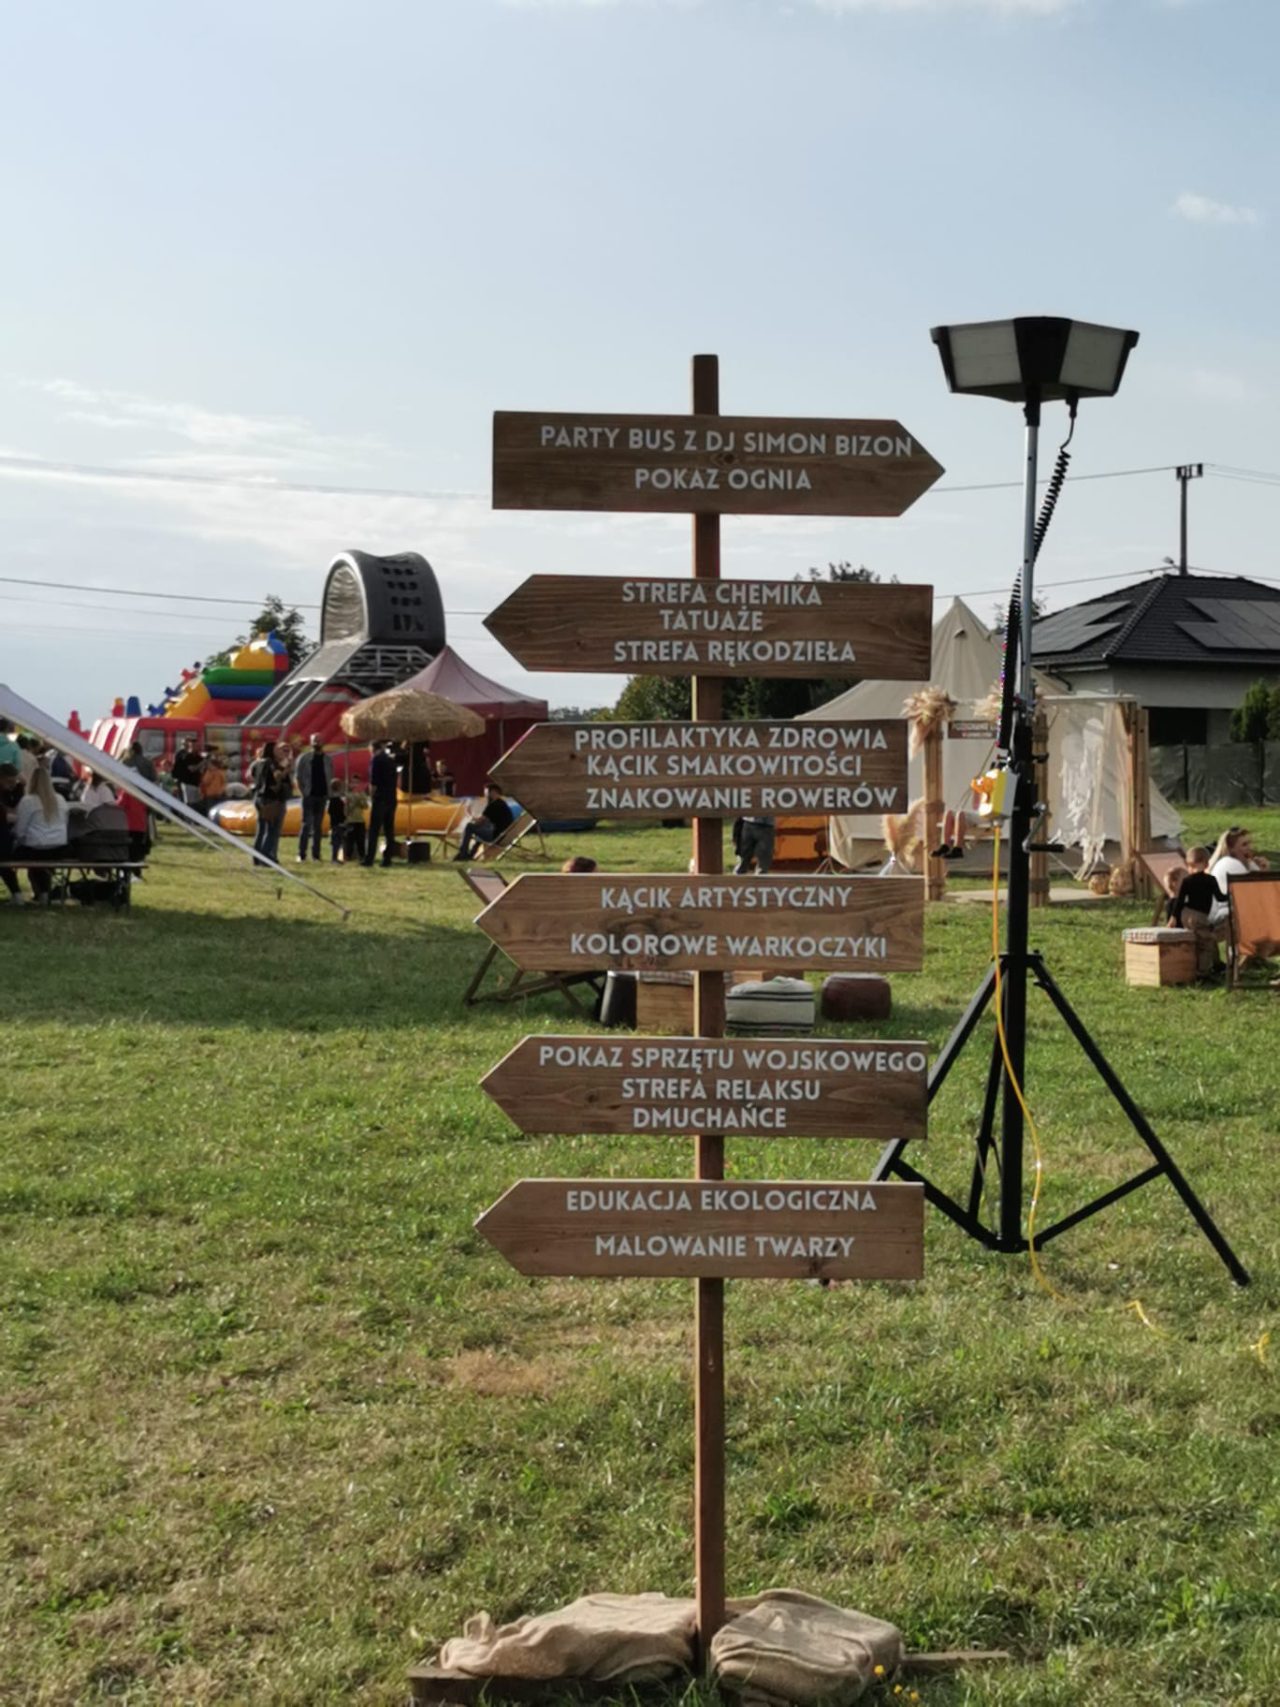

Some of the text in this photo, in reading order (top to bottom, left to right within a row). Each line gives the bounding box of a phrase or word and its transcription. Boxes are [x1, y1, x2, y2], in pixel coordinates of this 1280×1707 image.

[541, 426, 912, 456] PARTY BUS Z DJ SIMON BIZON
[635, 469, 811, 490] POKAZ OGNIA
[622, 582, 821, 606] STREFA CHEMIKA
[660, 604, 763, 631] TATUAŻE
[614, 641, 855, 668] STREFA RĘKODZIEŁA
[575, 727, 887, 750] PROFILAKTYKA ZDROWIA
[587, 751, 862, 782] KĄCIK SMAKOWITOŚCI
[587, 783, 897, 809] ZNAKOWANIE ROWERÓW
[601, 886, 852, 913] KĄCIK ARTYSTYCZNY
[571, 933, 886, 958] KOLOROWE WARKOCZYKI
[540, 1046, 926, 1074] POKAZ SPRZĘTU WOJSKOWEGO
[622, 1078, 820, 1101] STREFA RELAKSU
[633, 1103, 786, 1128] DMUCHAŃCE
[567, 1190, 876, 1211] EDUKACJA EKOLOGICZNA
[596, 1236, 855, 1257] MALOWANIE TWARZY
